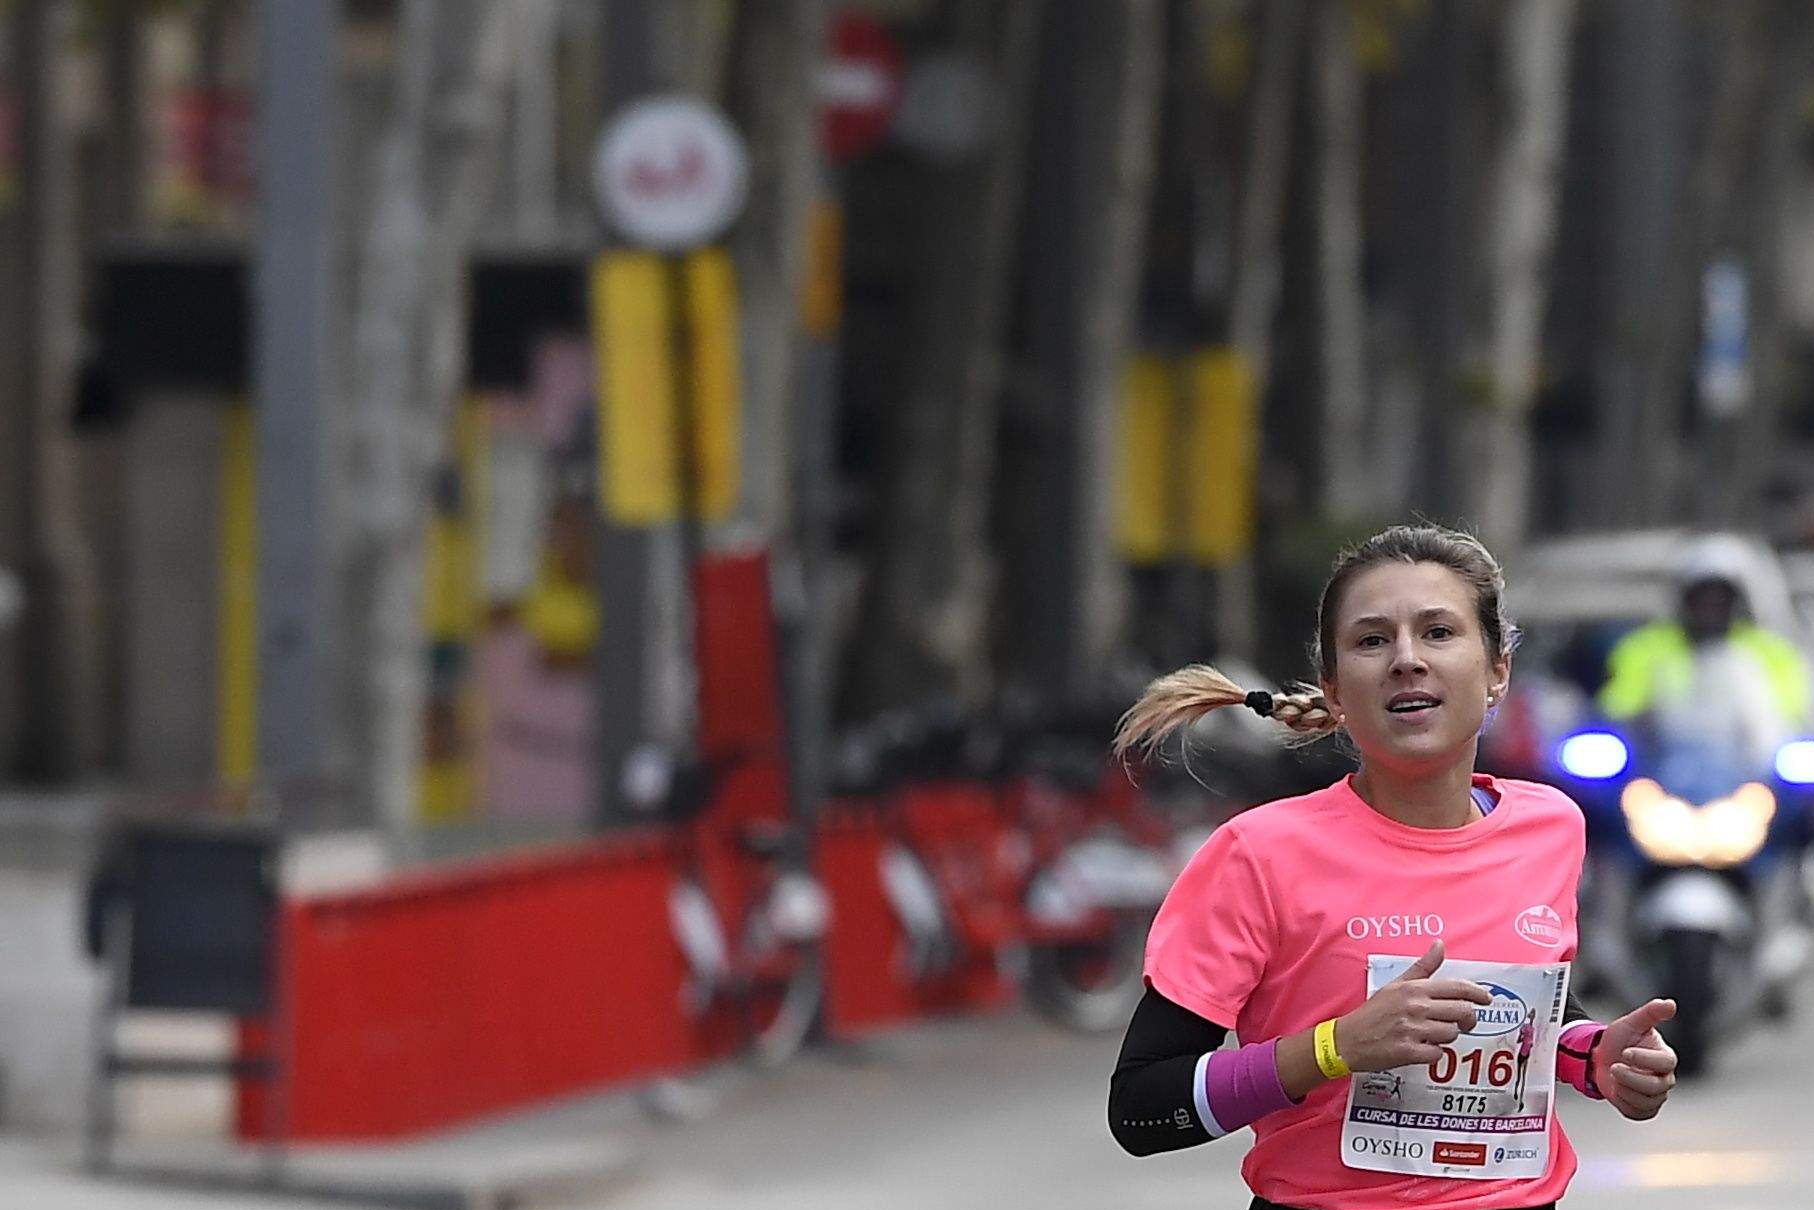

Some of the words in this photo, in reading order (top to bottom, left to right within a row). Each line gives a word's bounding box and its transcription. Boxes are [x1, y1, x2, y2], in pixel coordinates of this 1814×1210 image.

[1347, 914, 1444, 940] OYSHO
[1475, 1009, 1519, 1024] RIANA
[1429, 1047, 1514, 1087] 016
[1442, 1095, 1487, 1114] 8175
[1357, 1109, 1397, 1123] CURSA
[1399, 1113, 1416, 1126] DE
[1417, 1115, 1439, 1127] LES
[1441, 1117, 1478, 1130] DONES
[1480, 1119, 1494, 1131] DE
[1495, 1118, 1543, 1131] BARCELONA
[1352, 1136, 1424, 1159] OYSHO
[1506, 1149, 1537, 1160] ZURICH
